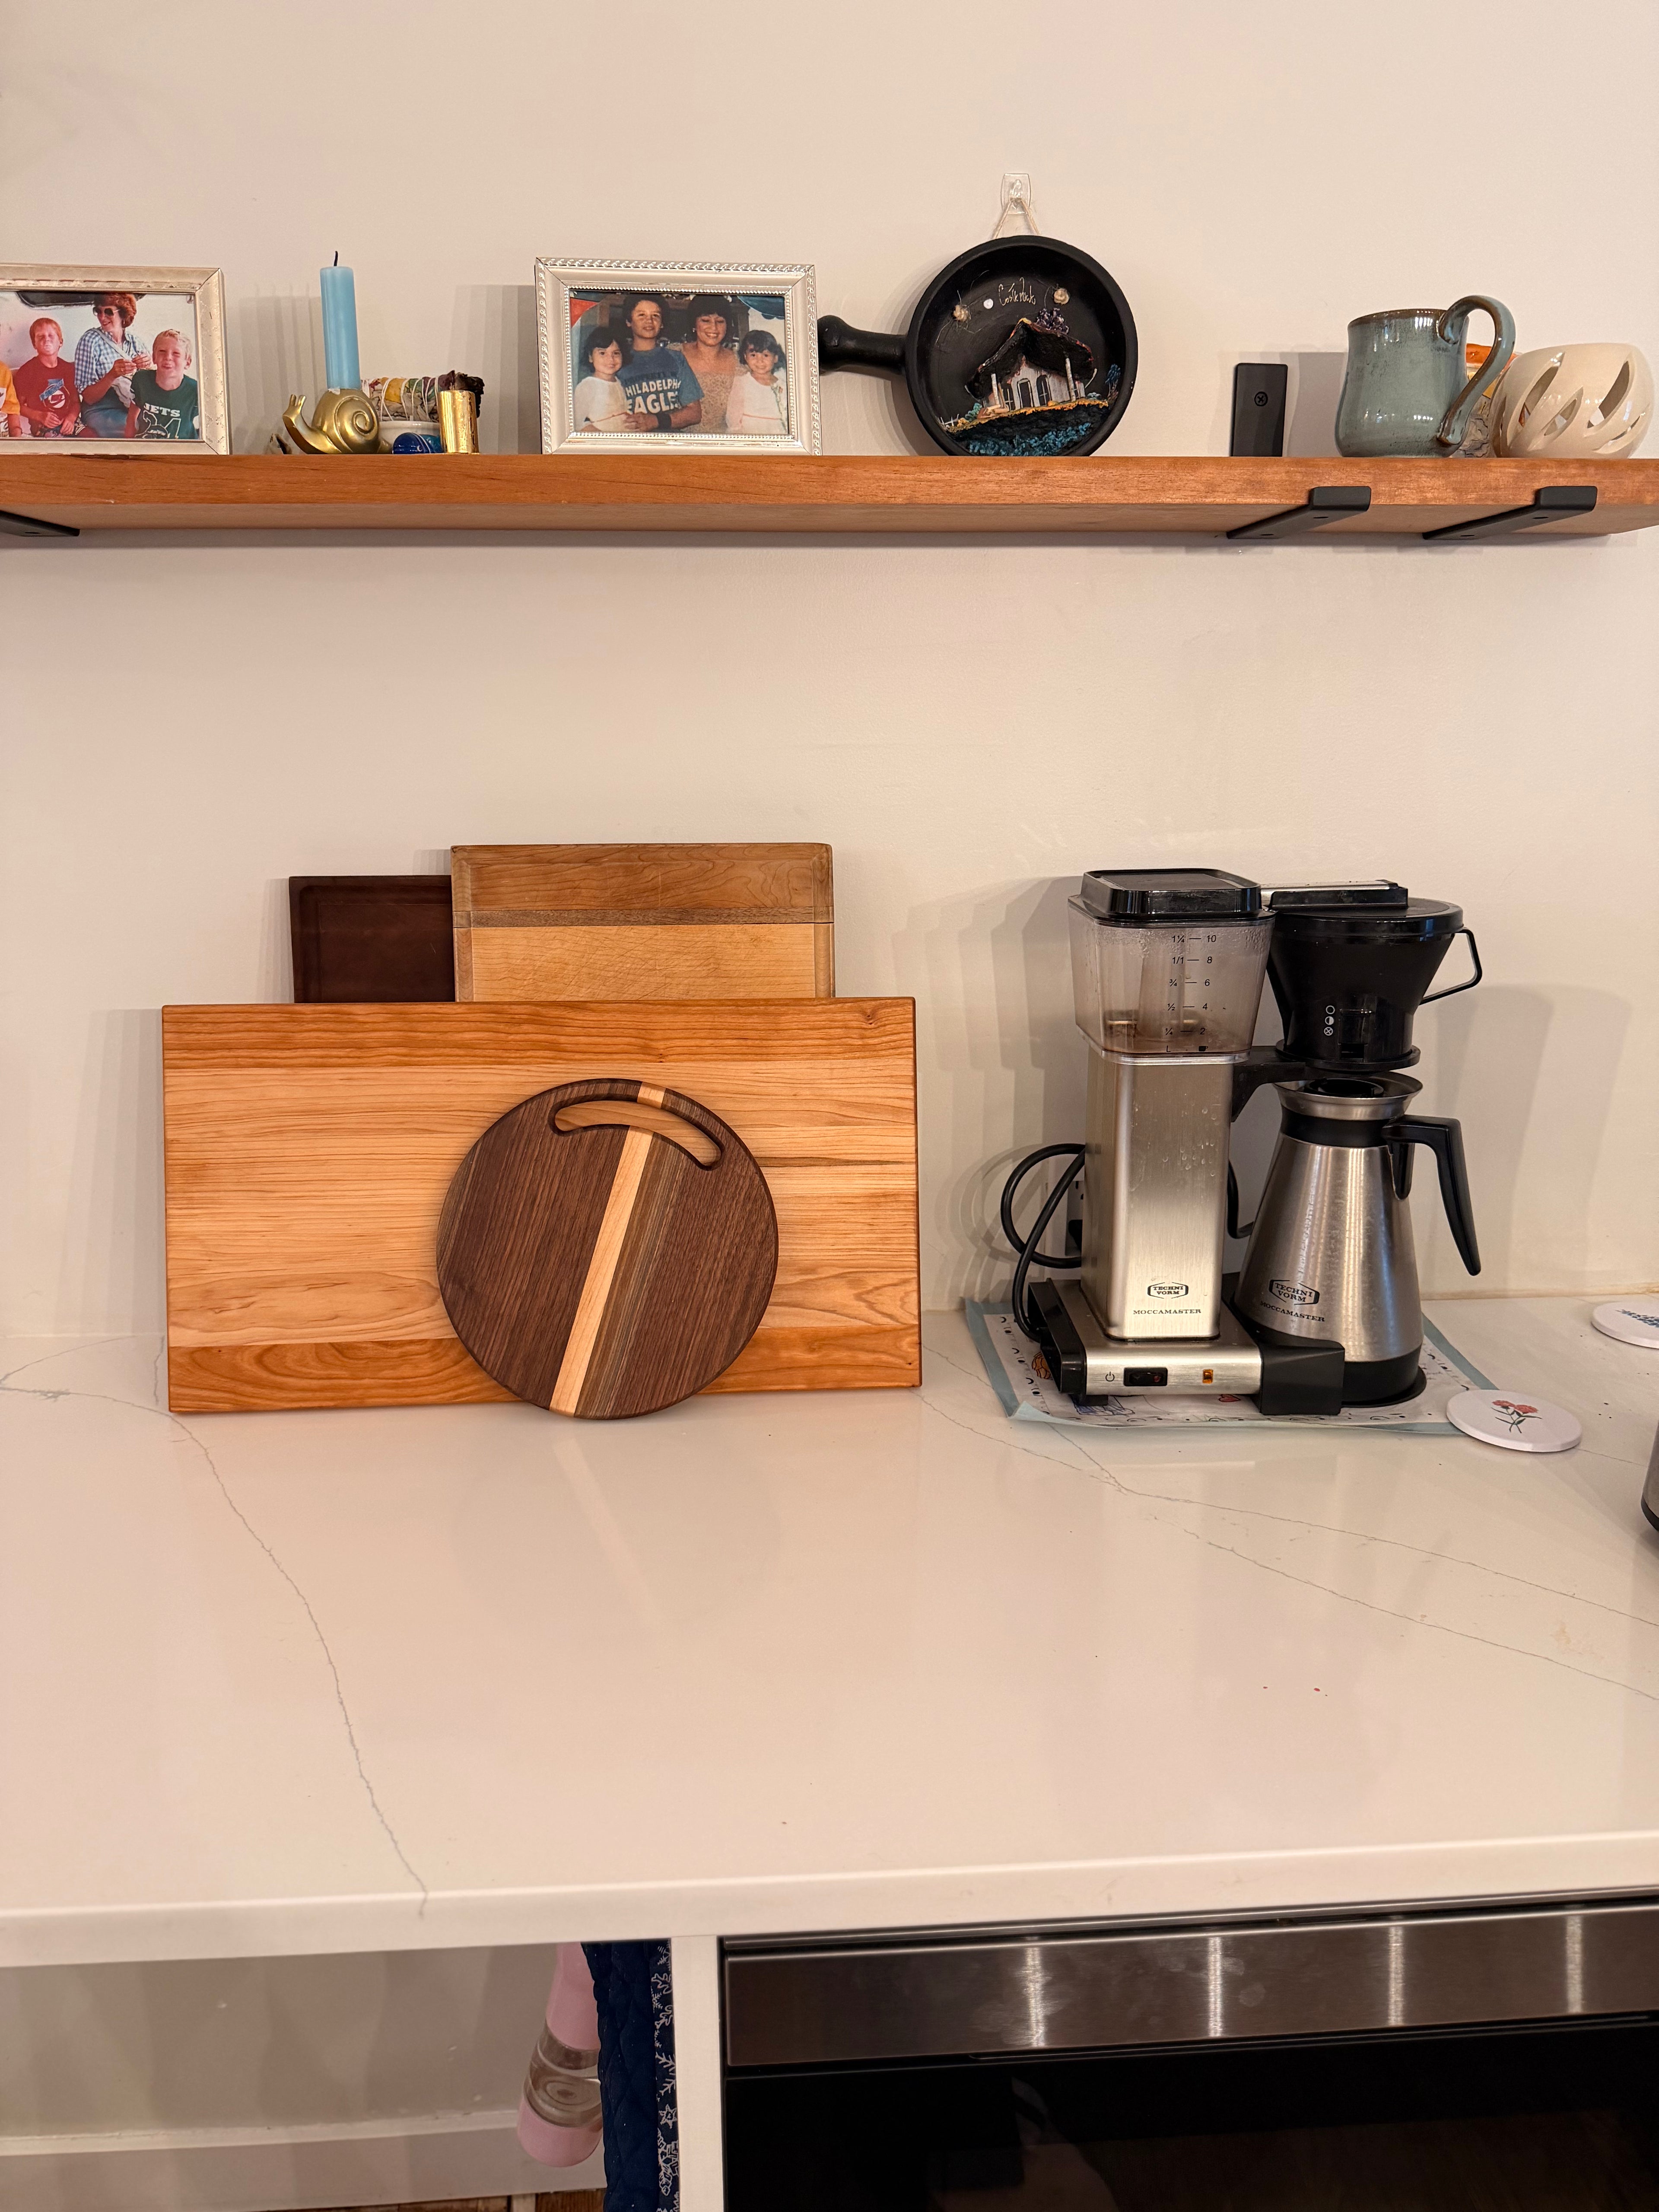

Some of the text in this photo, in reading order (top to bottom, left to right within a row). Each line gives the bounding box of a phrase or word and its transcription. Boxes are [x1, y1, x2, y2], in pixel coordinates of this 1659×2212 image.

[626, 378, 681, 397] HILADELPH
[143, 403, 181, 417] JETS
[1172, 956, 1184, 964] 1/1
[1275, 1283, 1313, 1297] TECHNI
[1278, 1290, 1306, 1303] VORM
[1260, 1300, 1325, 1322] MOCCAMASTER
